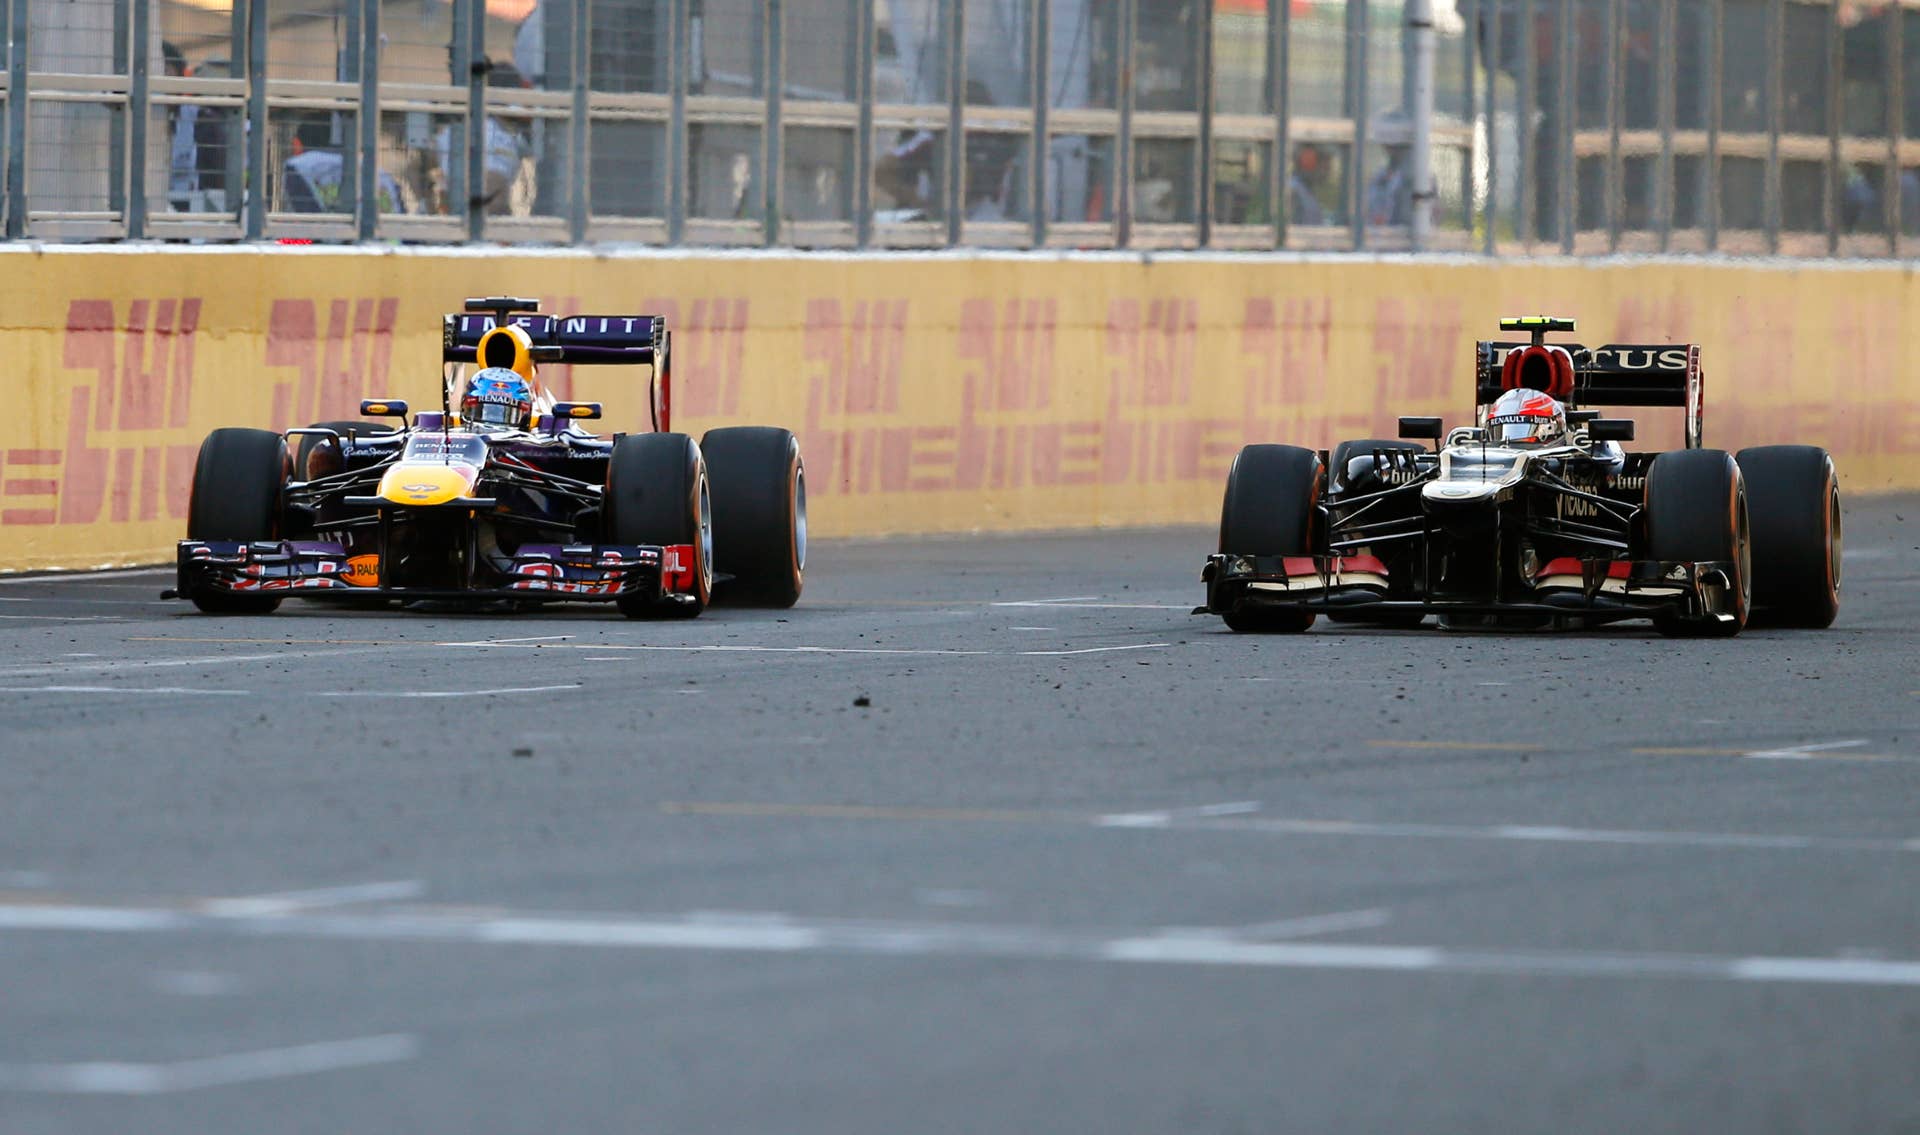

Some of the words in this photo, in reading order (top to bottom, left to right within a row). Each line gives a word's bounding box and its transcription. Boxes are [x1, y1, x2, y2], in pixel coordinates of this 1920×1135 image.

[1493, 348, 1687, 370] LTUS
[478, 394, 519, 406] RENAULT
[1490, 415, 1526, 426] RENAULT
[1617, 474, 1645, 489] bur
[357, 564, 379, 576] RAUC
